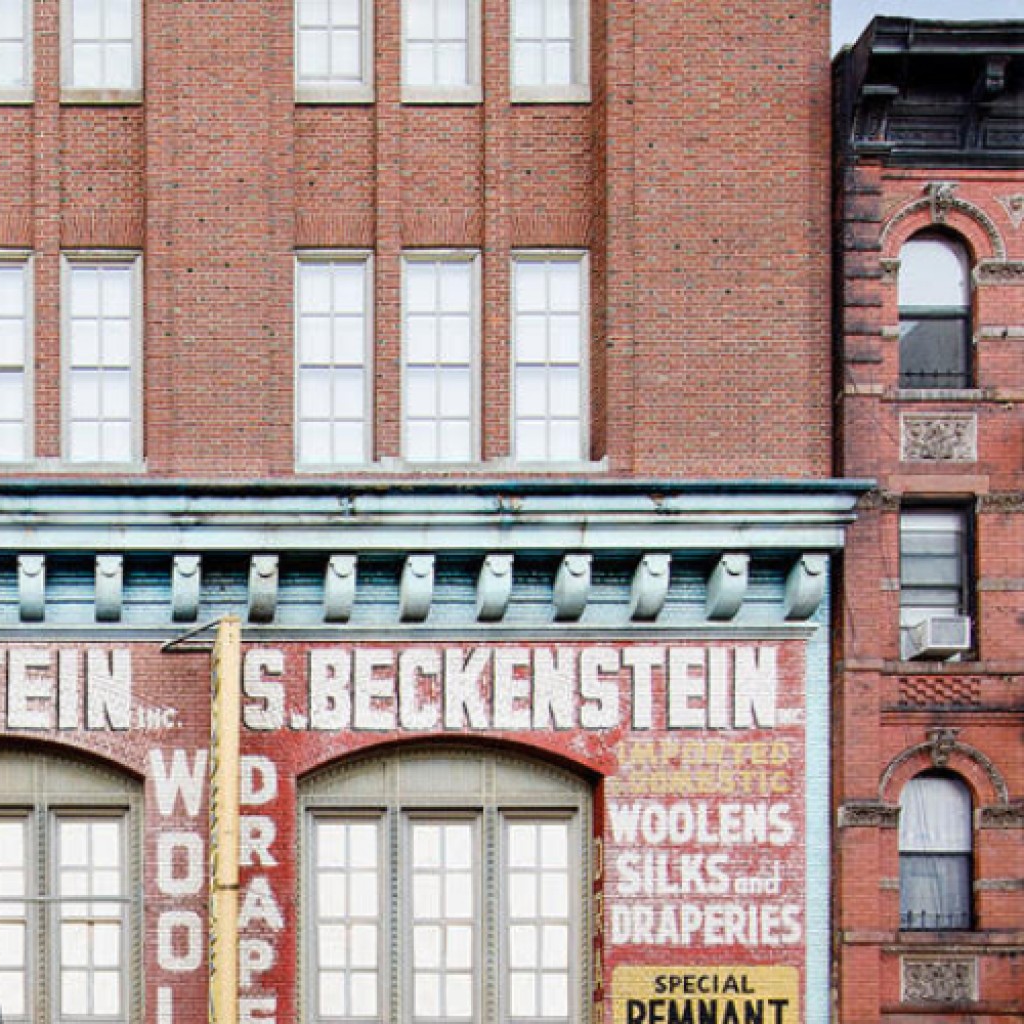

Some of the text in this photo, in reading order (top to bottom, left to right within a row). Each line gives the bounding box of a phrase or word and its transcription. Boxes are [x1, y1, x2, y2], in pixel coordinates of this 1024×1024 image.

[240, 645, 777, 730] S.BECKENSTEIN
[608, 801, 795, 844] WOOLENS
[615, 853, 730, 894] SILKS
[610, 904, 802, 943] DRAPERIES
[655, 975, 755, 994] SPECIAL
